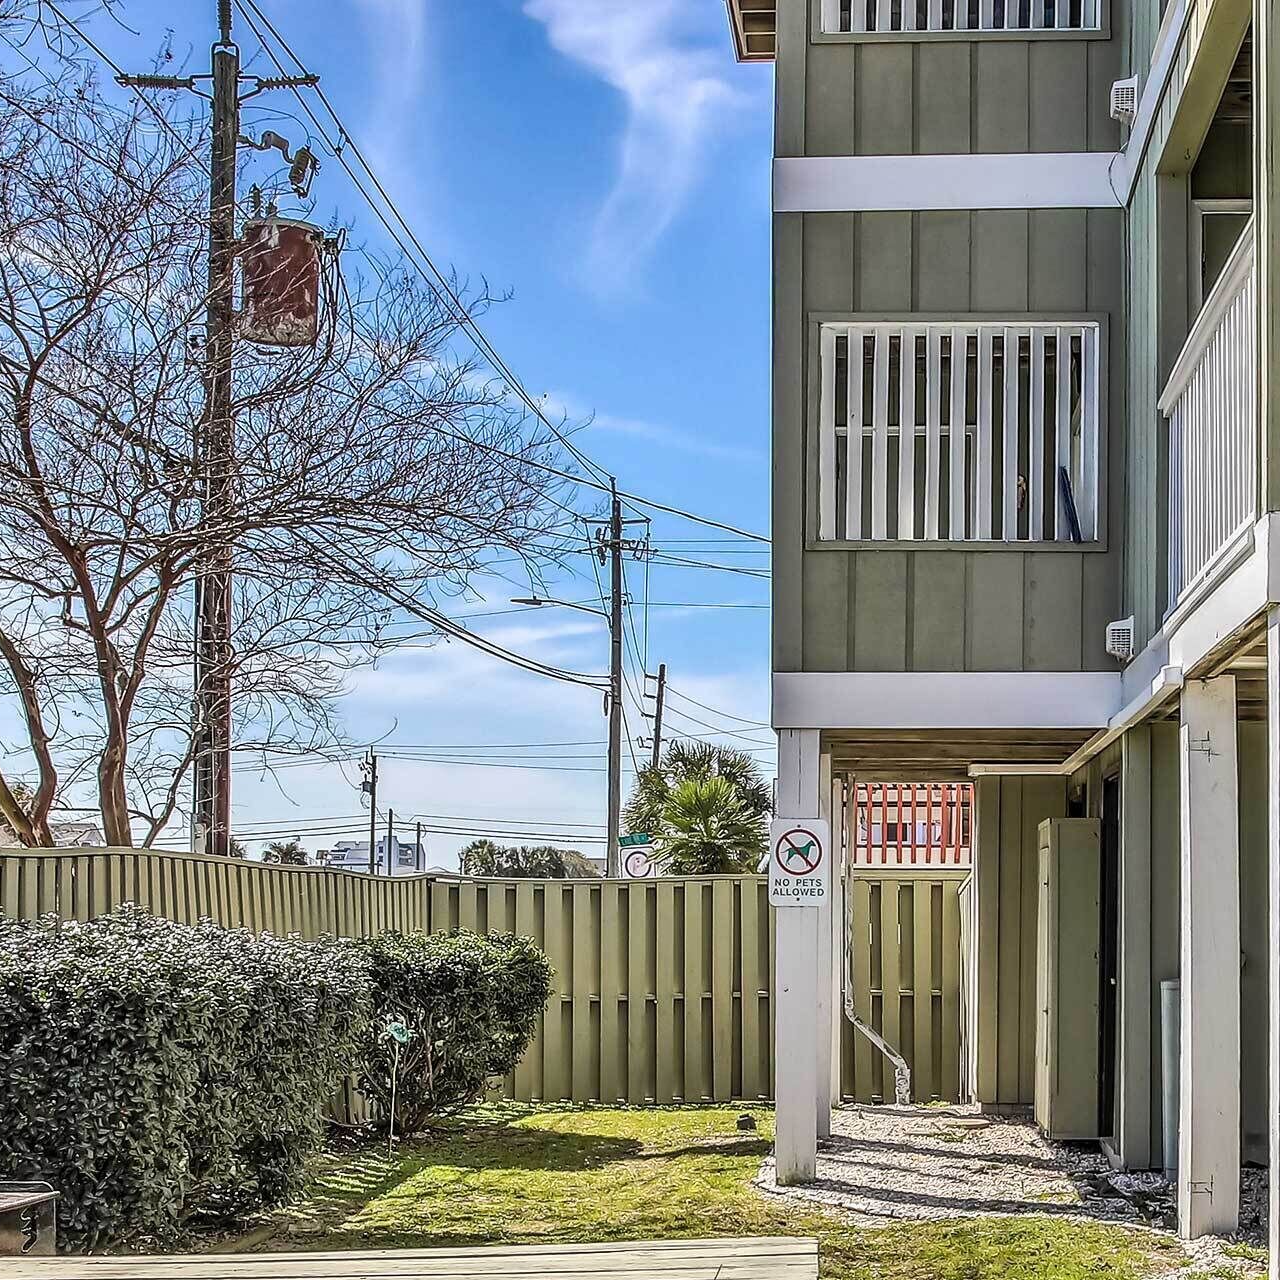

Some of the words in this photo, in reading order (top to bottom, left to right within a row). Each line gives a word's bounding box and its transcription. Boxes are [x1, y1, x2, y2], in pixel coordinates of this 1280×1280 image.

[774, 878, 790, 886] NO
[796, 878, 822, 886] PETS
[773, 888, 824, 896] ALLOWED
